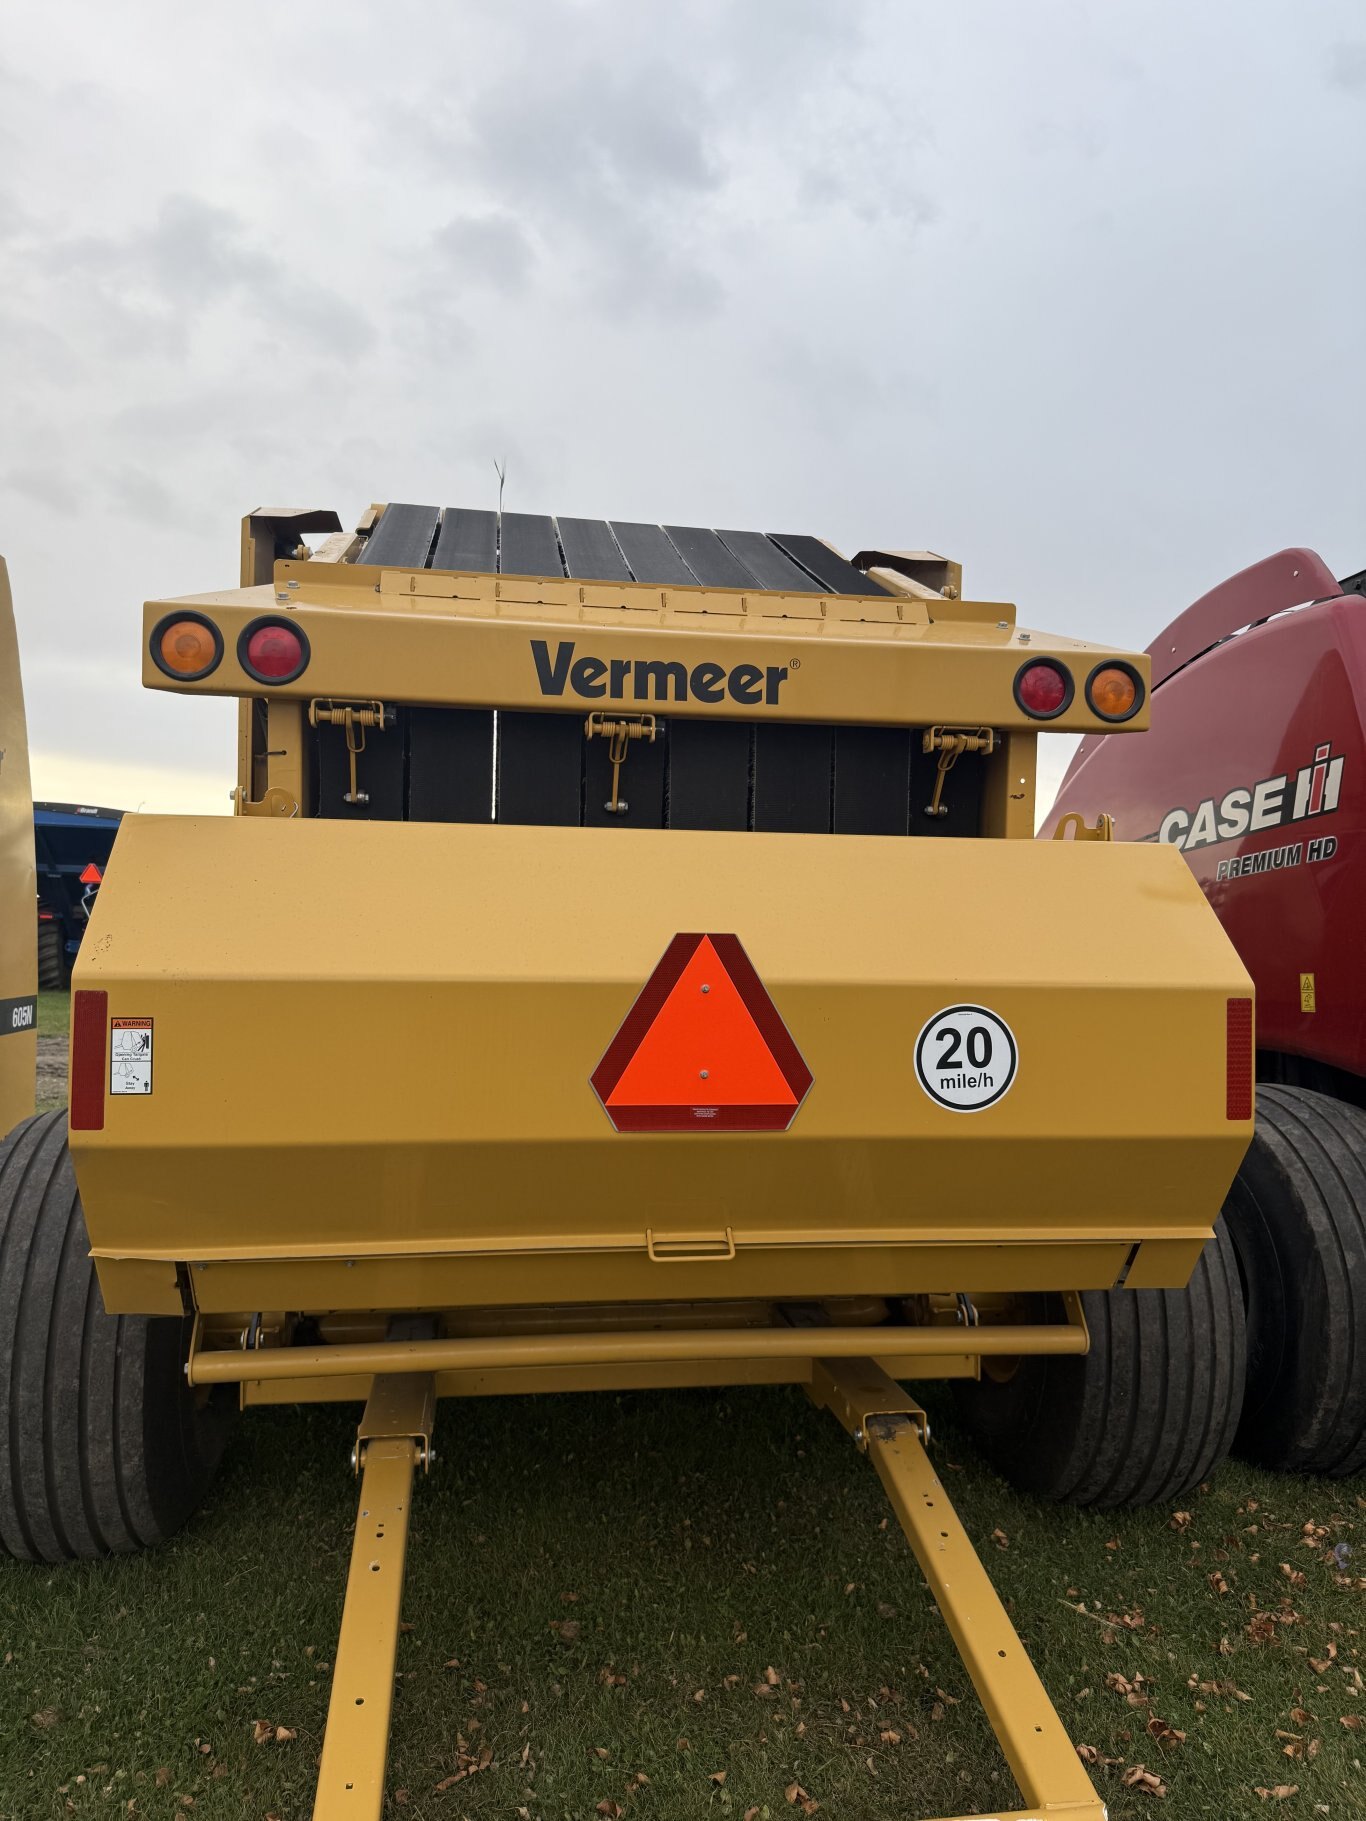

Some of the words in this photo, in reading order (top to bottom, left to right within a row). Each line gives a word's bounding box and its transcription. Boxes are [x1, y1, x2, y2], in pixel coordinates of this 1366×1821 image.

[1158, 775, 1288, 850] CASE
[1216, 843, 1303, 881] PREMIUM
[1306, 836, 1338, 863] HD
[12, 1004, 33, 1028] 605N
[935, 1026, 993, 1070] 20
[940, 1072, 994, 1089] mile/h
